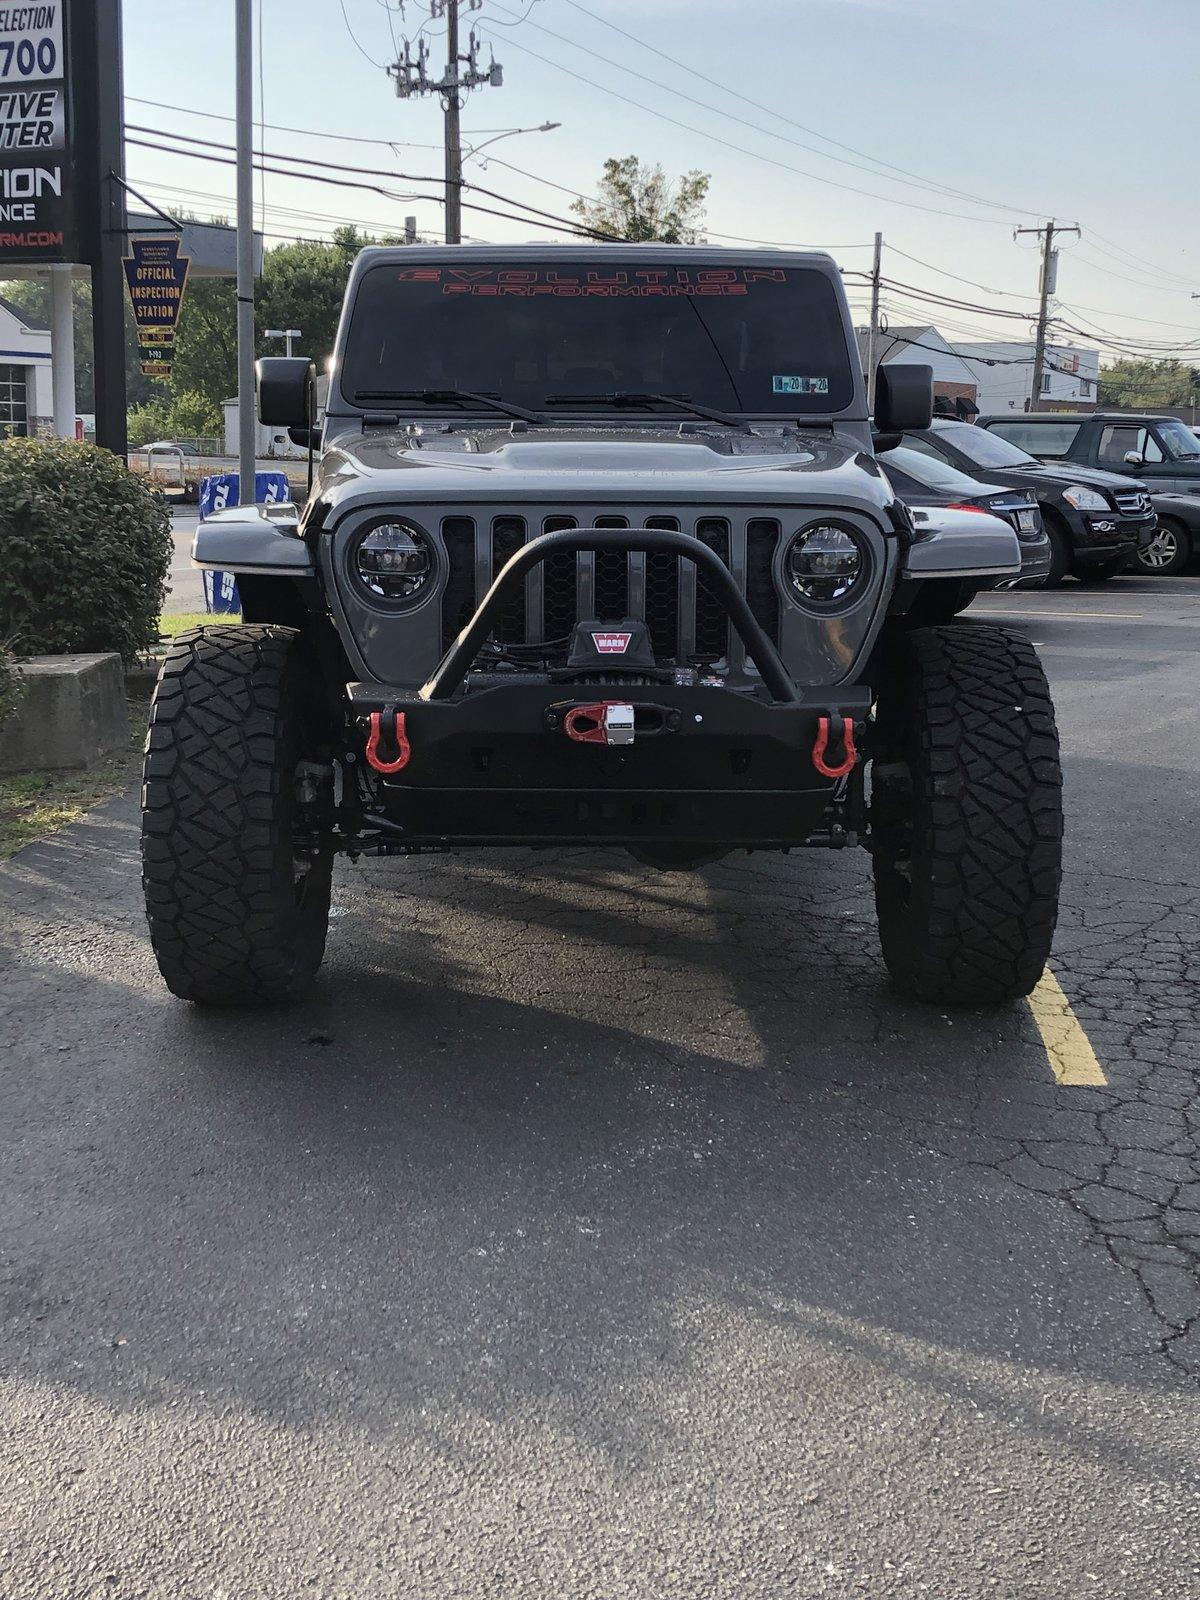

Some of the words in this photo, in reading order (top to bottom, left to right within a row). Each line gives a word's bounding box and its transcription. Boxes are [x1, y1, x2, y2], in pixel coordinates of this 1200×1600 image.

[0, 37, 56, 76] 700
[0, 120, 54, 147] TER
[0, 166, 61, 198] ION
[136, 267, 176, 280] OFFICIAL
[399, 268, 787, 284] EVOLUTION
[131, 286, 180, 299] INSPECTION
[442, 283, 748, 297] PERFORMANCE
[137, 305, 174, 318] STATION
[221, 570, 236, 602] ES
[598, 639, 625, 648] WARN
